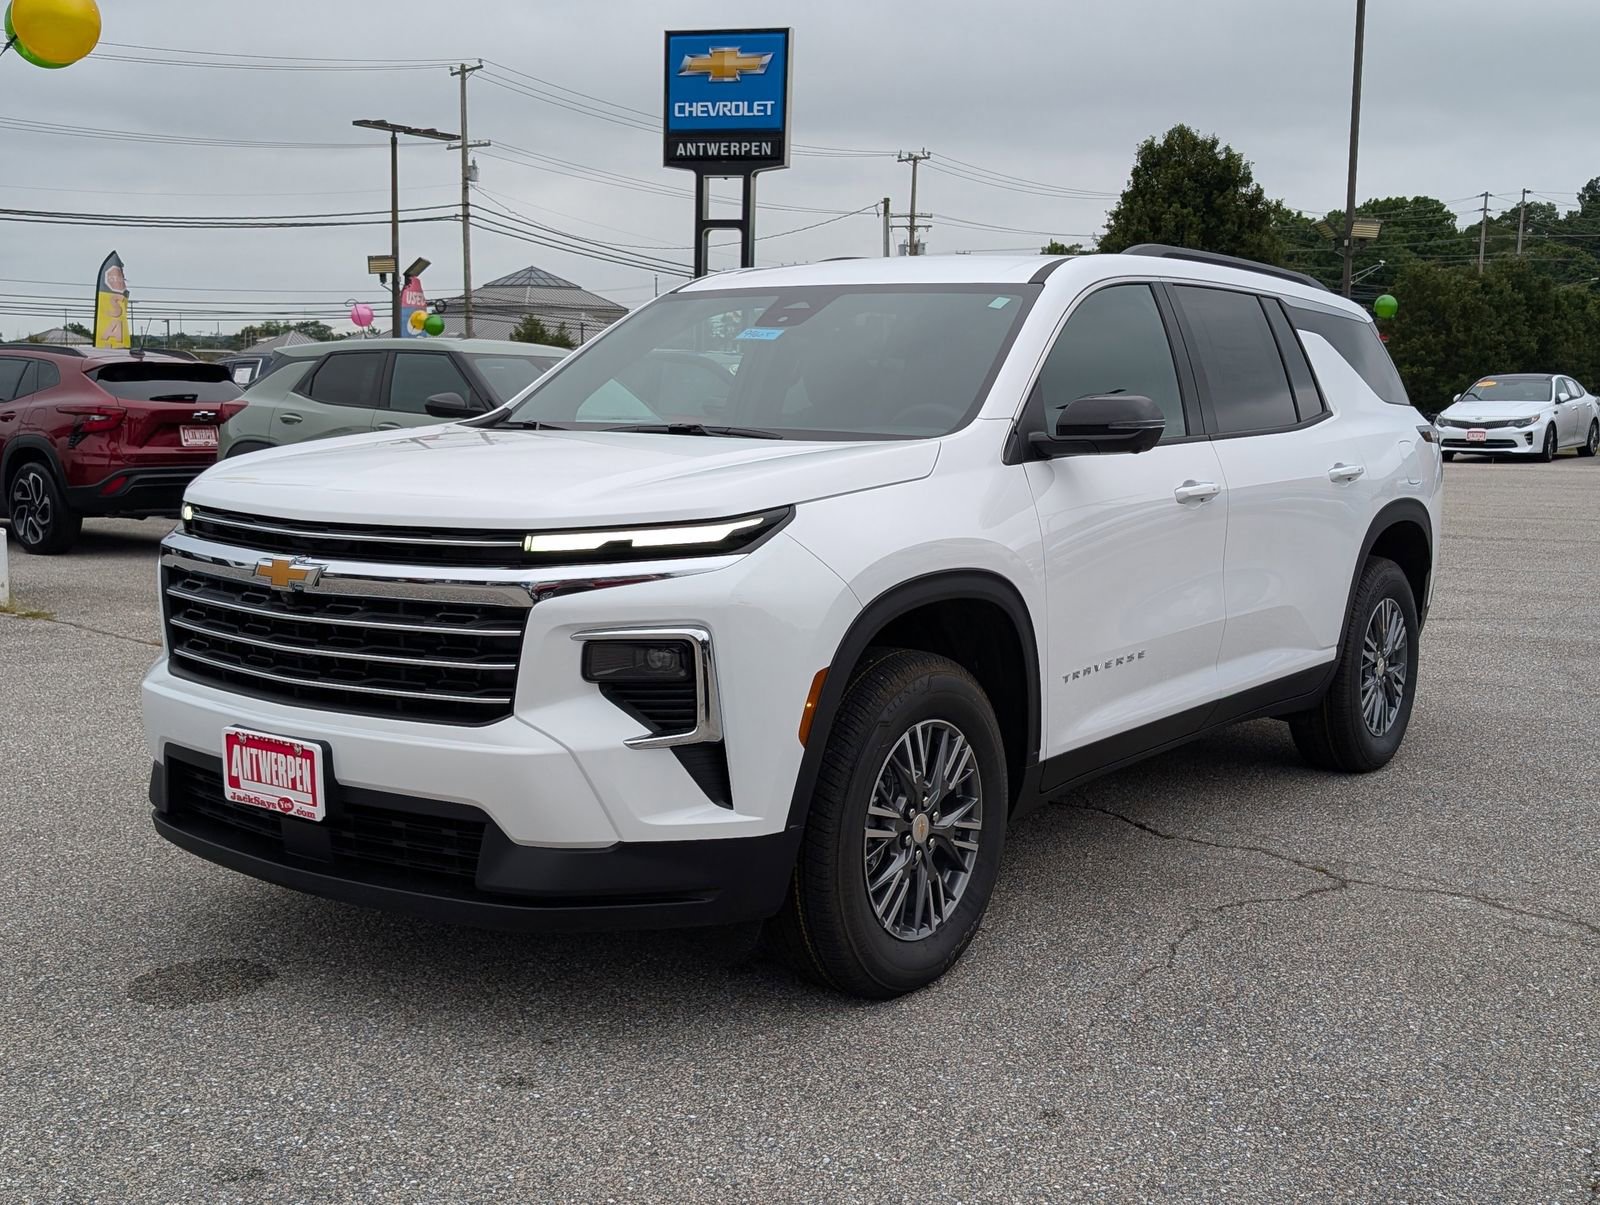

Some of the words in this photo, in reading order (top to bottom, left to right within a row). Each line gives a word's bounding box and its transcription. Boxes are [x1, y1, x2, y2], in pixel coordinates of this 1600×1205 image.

[674, 101, 775, 117] CHEVROLET
[676, 142, 771, 156] ANTWERPEN
[1062, 650, 1145, 684] TRAVERSE
[231, 744, 312, 793] ANTWERPEN
